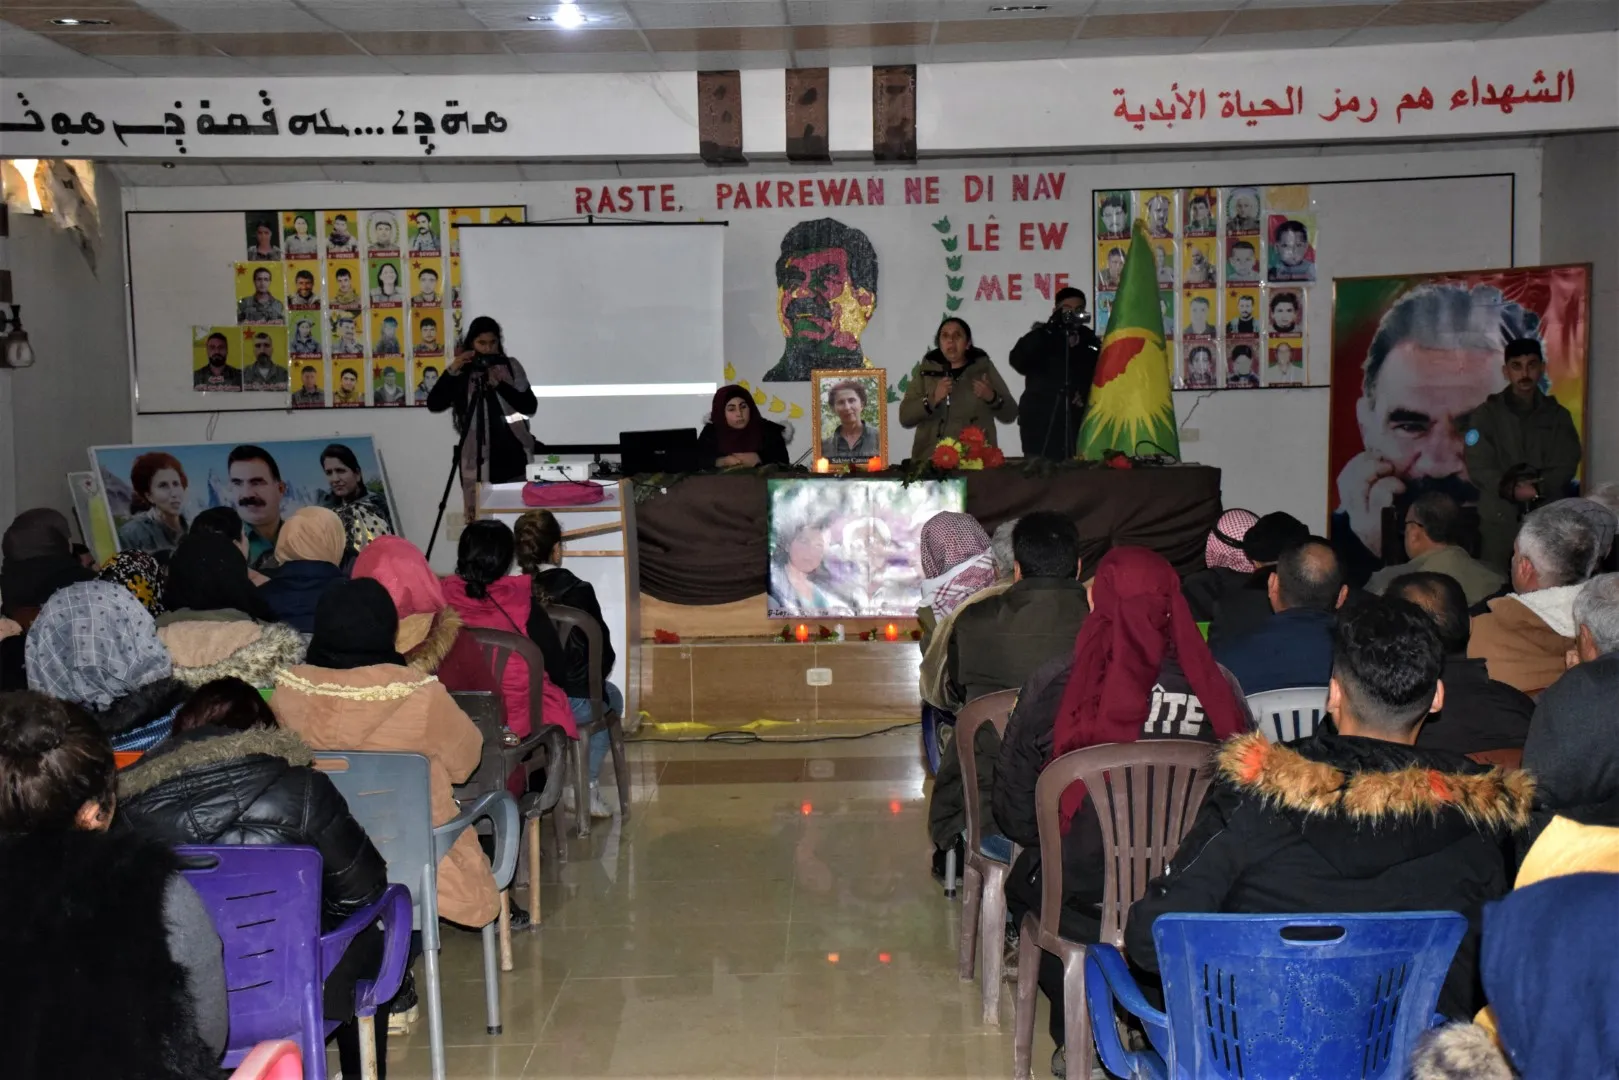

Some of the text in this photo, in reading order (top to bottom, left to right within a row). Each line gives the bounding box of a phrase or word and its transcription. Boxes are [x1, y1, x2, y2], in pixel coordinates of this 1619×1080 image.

[1112, 69, 1576, 130] الشهداء هم رمز الحياة الأبدية
[716, 178, 885, 209] PAKREWAN
[904, 176, 940, 205] NE
[964, 175, 994, 203] DI
[1011, 172, 1066, 202] NAV
[967, 214, 1069, 252] LÊ EW
